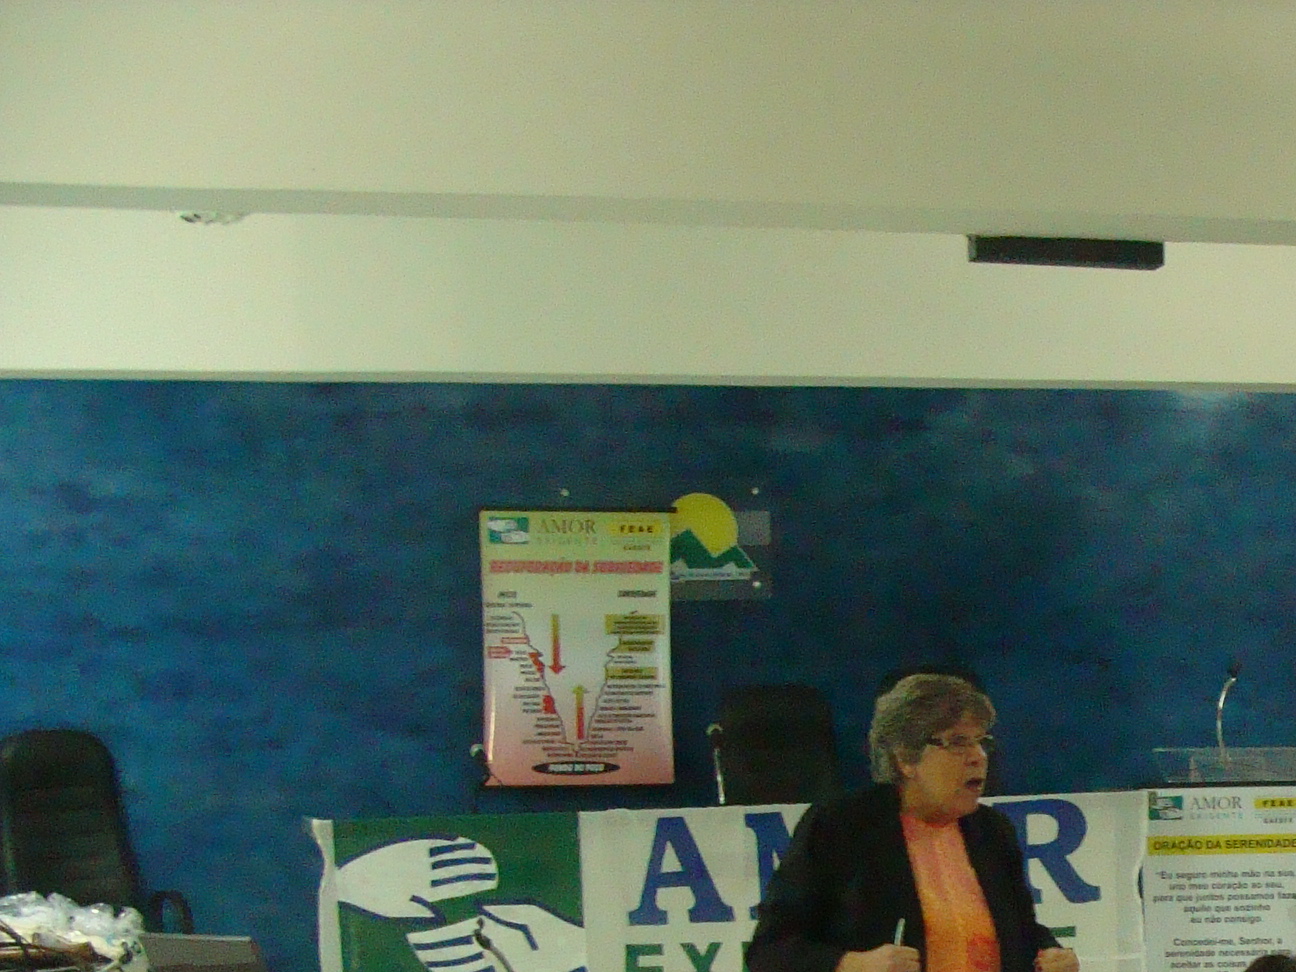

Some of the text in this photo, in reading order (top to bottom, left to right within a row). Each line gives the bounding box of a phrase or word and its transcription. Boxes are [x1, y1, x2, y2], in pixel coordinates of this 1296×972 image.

[537, 518, 597, 534] AMOR
[1191, 795, 1243, 810] AMOR
[1153, 838, 1202, 851] ORAÇÃO
[1206, 839, 1222, 849] DA
